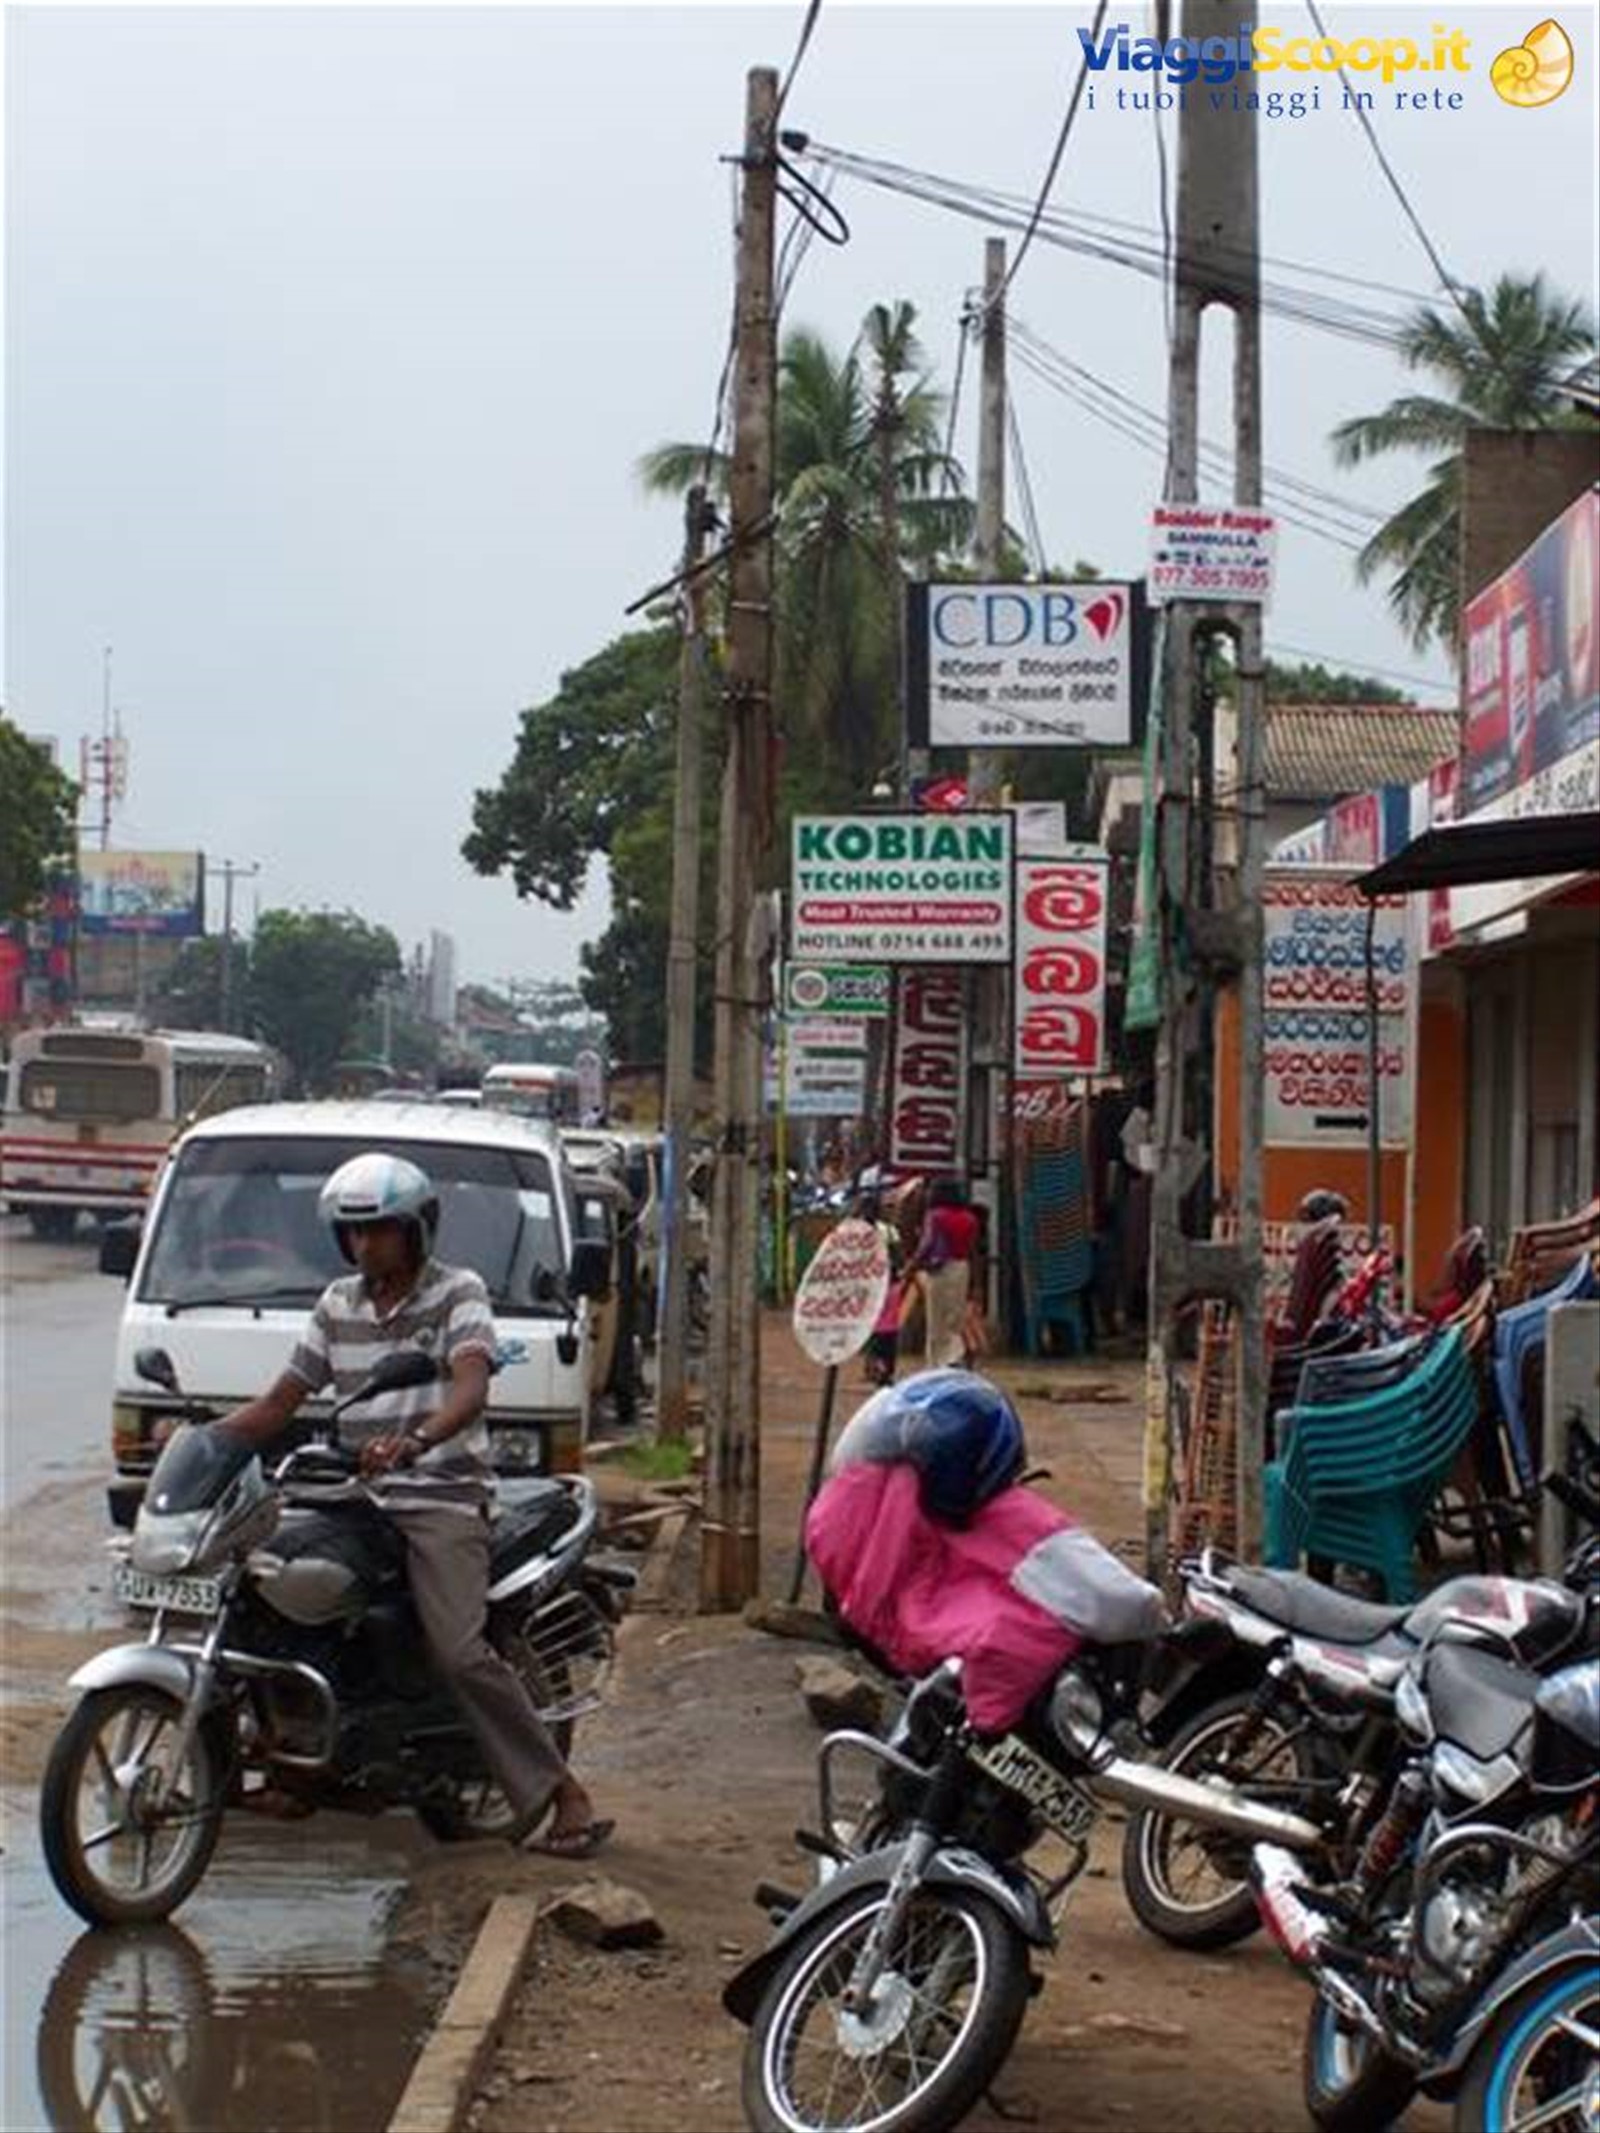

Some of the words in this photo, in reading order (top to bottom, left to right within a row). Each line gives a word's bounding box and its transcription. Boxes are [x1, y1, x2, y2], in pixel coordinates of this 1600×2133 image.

[933, 593, 1077, 647] CDB
[799, 824, 1003, 861] KOBIAN
[799, 871, 1001, 891] TECHNOLOGIES
[851, 904, 914, 920] Trusted
[915, 904, 998, 923] Warranty
[799, 932, 874, 949] HOTLINE
